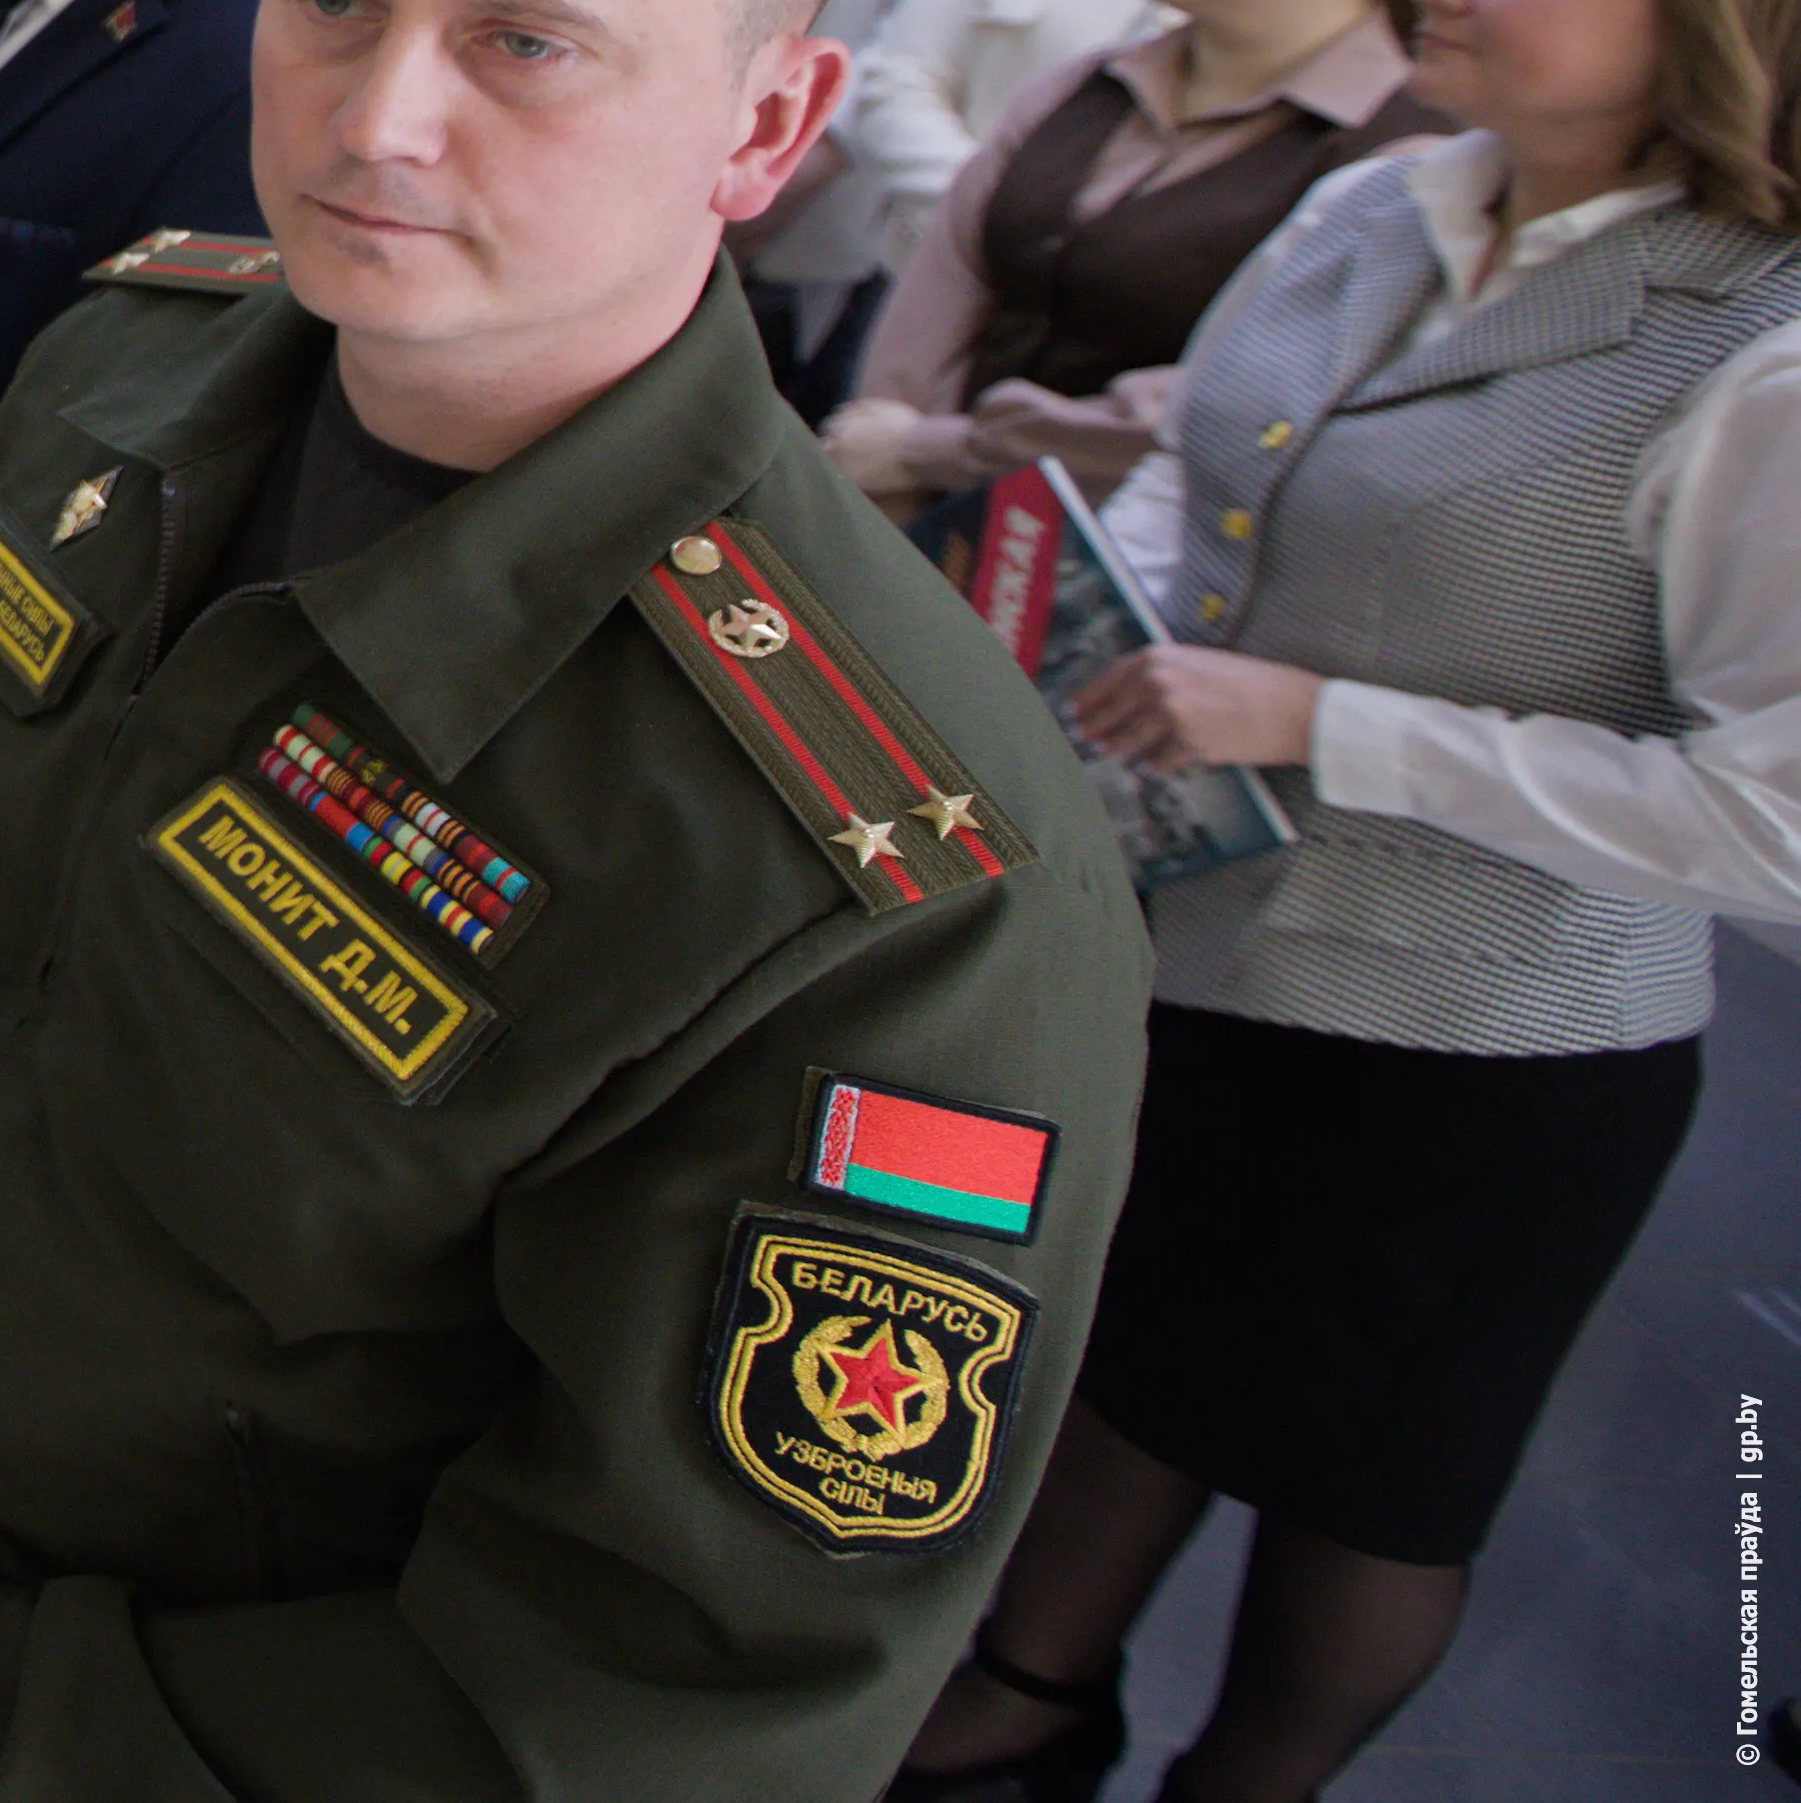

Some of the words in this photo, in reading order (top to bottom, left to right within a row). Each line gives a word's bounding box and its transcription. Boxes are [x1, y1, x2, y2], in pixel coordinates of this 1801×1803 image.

[21, 596, 55, 636] СИЛЫ
[199, 815, 339, 942] МОНИТ
[321, 939, 418, 1035] Д.М.
[791, 1260, 988, 1343] БЕЛАРУСЬ
[775, 1431, 937, 1504] УЗБРОЕНЫЯ
[818, 1478, 885, 1516] СІЛЫ
